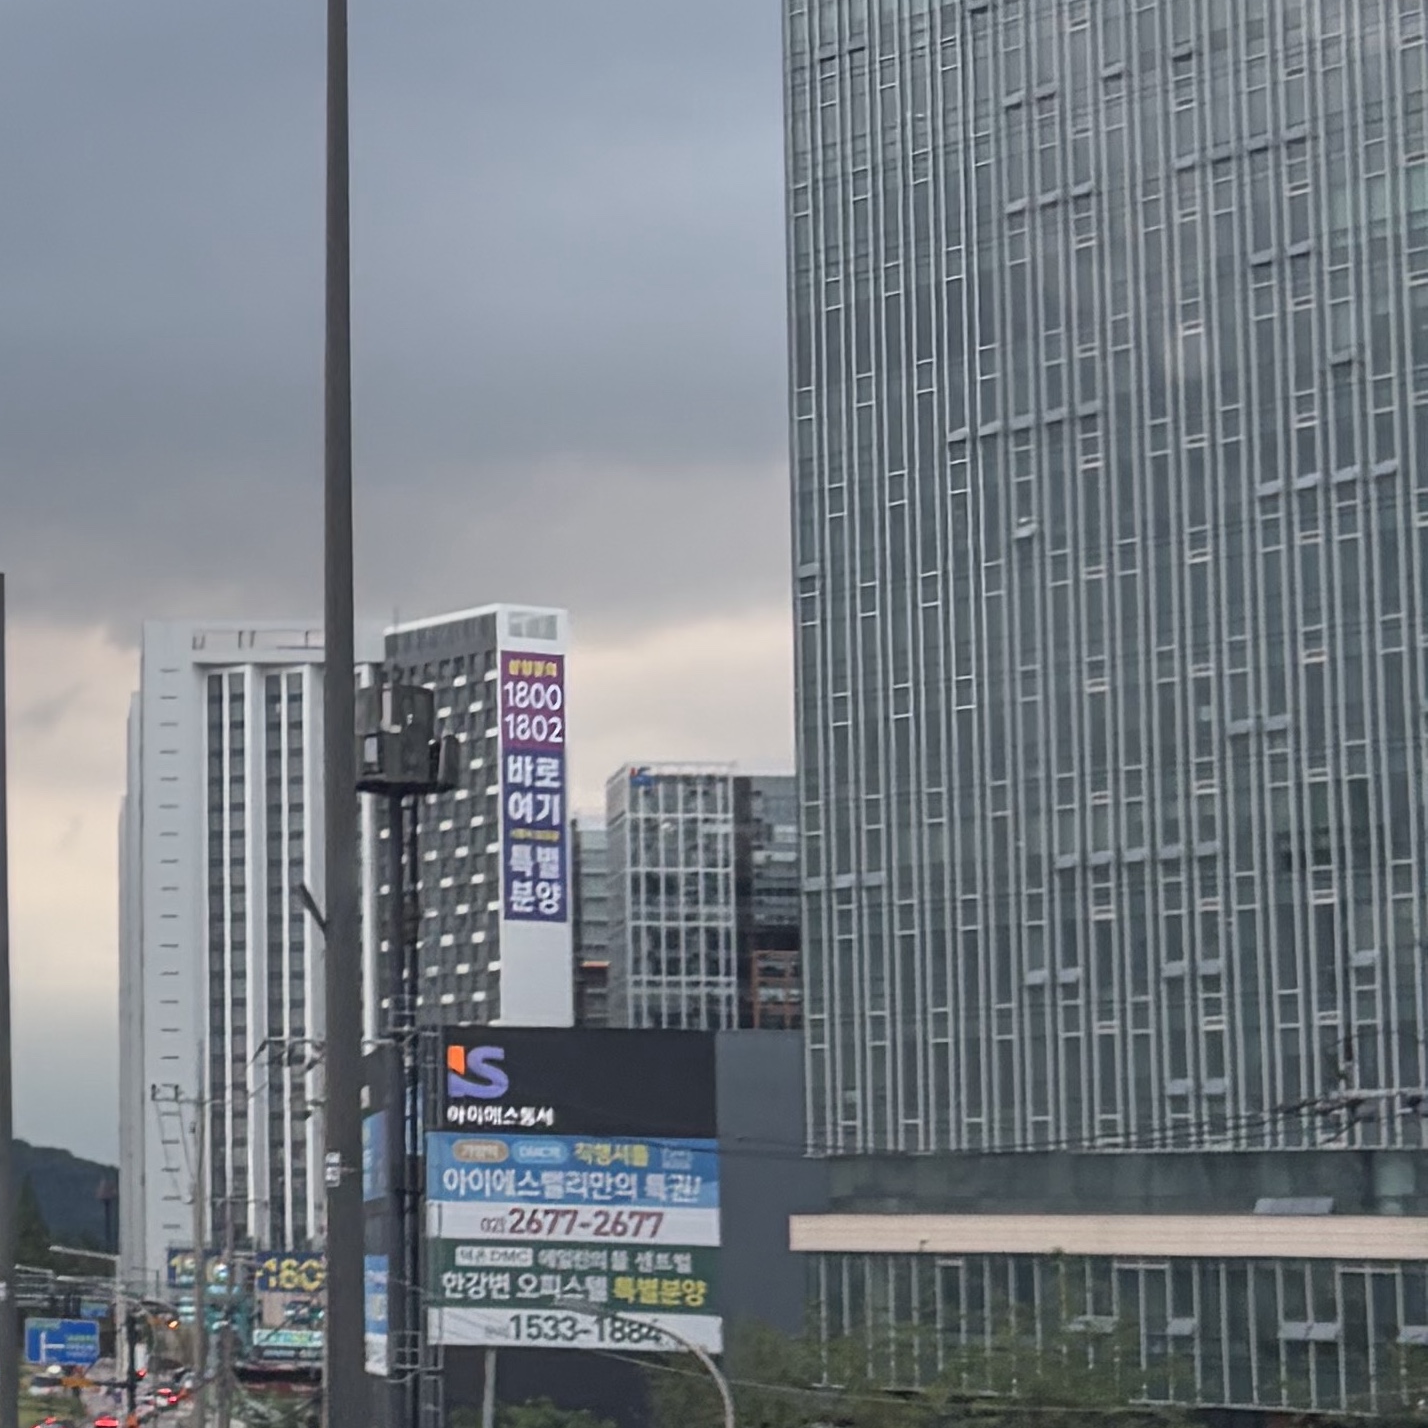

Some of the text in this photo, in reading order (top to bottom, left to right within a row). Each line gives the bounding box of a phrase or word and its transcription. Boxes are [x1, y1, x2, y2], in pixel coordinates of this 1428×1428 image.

[504, 681, 562, 710] 1800
[505, 713, 563, 743] 1802
[507, 754, 561, 788] 바로
[508, 791, 560, 826] 여기
[509, 879, 561, 914] 분양
